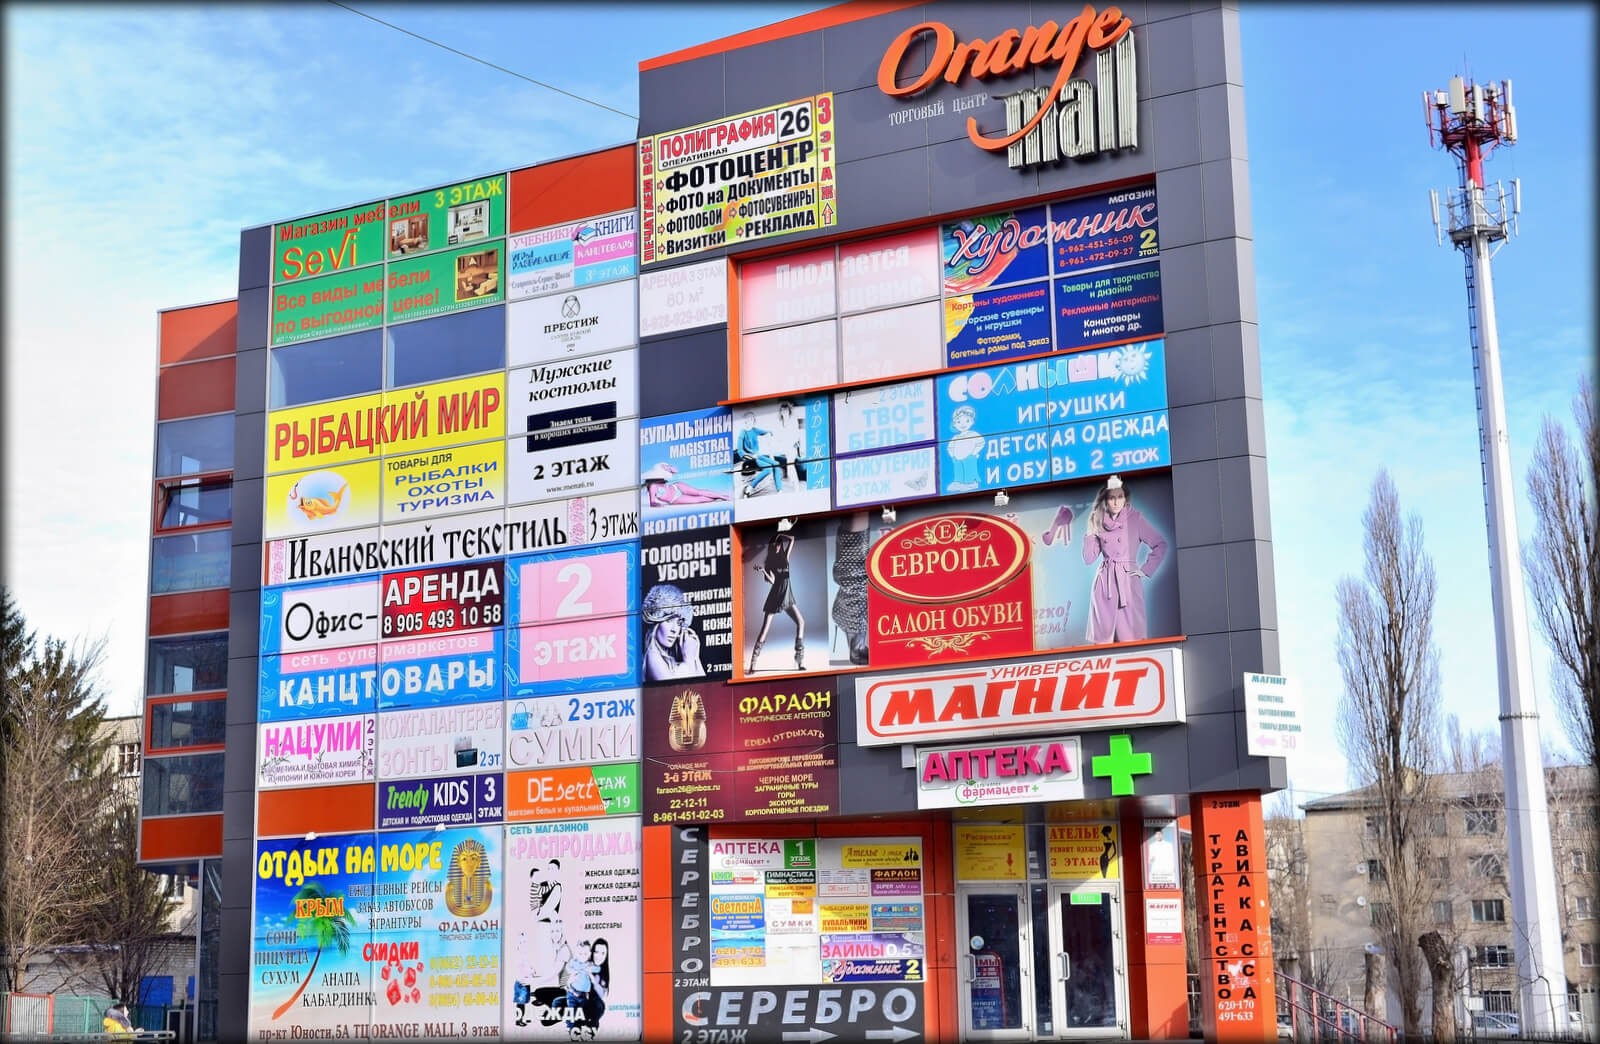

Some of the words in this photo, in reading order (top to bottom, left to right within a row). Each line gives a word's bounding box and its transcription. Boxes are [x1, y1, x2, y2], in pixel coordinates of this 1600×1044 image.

[877, 4, 1132, 150] Orange
[818, 97, 831, 124] 3
[888, 101, 944, 126] ТОРГОВЫЙ
[951, 92, 988, 112] ЦЕНТР
[991, 30, 1138, 168] mall
[660, 112, 776, 161] ПОЛИГРАФИЯ
[779, 107, 810, 137] 26
[662, 147, 728, 168] ОПЕРАТИВНАЯ
[665, 140, 814, 192] ФОТОЦЕНТР
[434, 191, 445, 209] 3
[450, 178, 503, 205] ЭТАЖ
[666, 192, 704, 213] ФОТО
[707, 190, 724, 205] на
[727, 167, 815, 203] ДОКУМЕНТЫ
[1108, 188, 1155, 205] магазин
[738, 188, 815, 219] ФОТОСУВЕНИРЫ
[280, 213, 348, 241] Магазин
[353, 200, 420, 227] мебели
[595, 215, 635, 237] КНИГИ
[667, 208, 722, 235] ФОТООБОИ
[744, 210, 816, 238] РЕКЛАМА
[666, 231, 726, 255] ВИЗИТКИ
[951, 203, 1159, 275] Художник
[1059, 235, 1134, 255] 8-962-451-56-09
[1140, 229, 1157, 249] 2
[1059, 247, 1134, 267] 8-961-472-09-27
[1138, 248, 1159, 256] этаж
[276, 291, 306, 312] Все
[312, 281, 358, 305] виды
[363, 269, 430, 293] мебели
[1062, 281, 1093, 294] Товары
[1095, 279, 1110, 290] для
[1113, 270, 1160, 285] творчества
[275, 319, 296, 335] по
[301, 300, 384, 332] выгодной
[392, 288, 440, 314] цене!
[1061, 302, 1109, 317] Рекламные
[1110, 293, 1160, 309] материалы
[544, 316, 599, 334] ПРЕСТИЖ
[1083, 312, 1141, 329] Канцтовары
[529, 359, 612, 384] Мужские
[528, 377, 617, 402] костюмы
[1018, 391, 1125, 424] ИГРУШКИ
[275, 391, 428, 461] РЫБАЦКИЙ
[438, 387, 500, 435] МИР
[640, 413, 732, 446] КУПАЛЬНИКИ
[669, 438, 730, 459] MAGISTRAL
[985, 426, 1076, 460] ДЕТСКАЯ
[1081, 414, 1169, 443] ОДЕЖДА
[387, 455, 429, 472] ТОВАРЫ
[431, 453, 452, 466] ДЛЯ
[533, 464, 544, 480] 2
[690, 451, 730, 470] REBECA
[986, 467, 1000, 485] И
[1006, 456, 1076, 482] ОБУВЬ
[1091, 449, 1104, 470] 2
[1111, 447, 1159, 468] этаж
[395, 461, 498, 486] РЫБАЛКИ
[407, 478, 483, 497] ОХОТЫ
[397, 490, 495, 513] ТУРИЗМА
[643, 510, 731, 536] КОЛГОТКИ
[641, 538, 731, 566] ГОЛОВНЫЕ
[890, 541, 1001, 578] ЕВРОПА
[657, 558, 717, 582] УБОРЫ
[384, 567, 500, 607] АРЕНДА
[555, 563, 593, 615] 2
[383, 618, 392, 635] 8
[397, 612, 423, 632] 905
[427, 608, 455, 629] 493
[461, 607, 478, 626] 10
[483, 604, 502, 623] 58
[693, 601, 732, 617] ЗАМША
[877, 609, 946, 636] САЛОН
[952, 601, 1023, 629] ОБУВИ
[291, 653, 330, 669] сеть
[337, 636, 479, 665] супермаркетов
[533, 633, 617, 668] этаж
[990, 658, 1112, 679] УНИВЕРСАМ
[278, 659, 495, 708] КАНЦТОВАРЫ
[738, 690, 831, 714] ФАРАОН
[878, 667, 1150, 726] МАГНИТ
[568, 698, 580, 721] 2
[583, 699, 635, 720] этаж
[739, 714, 793, 724] ТУРИСТИЧЕСКОЕ
[793, 711, 831, 720] АГЕНТСТВО
[367, 719, 374, 733] 2
[265, 721, 361, 760] НАЦУМИ
[510, 724, 637, 766] СУМКИ
[382, 744, 449, 776] ЗОНТЫ
[480, 752, 486, 767] 2
[922, 743, 1073, 783] АПТЕКА
[484, 777, 495, 802] 3
[527, 776, 596, 803] DEsert
[754, 783, 799, 792] ЗАГРАНИЧНЫЕ
[800, 782, 818, 790] ТУРЫ
[759, 775, 790, 784] ЧЕРНОЕ
[791, 773, 813, 783] МОРЕ
[387, 784, 429, 815] Trendy
[433, 780, 469, 807] KIDS
[769, 799, 804, 807] ЭКСКУРСИИ
[777, 791, 795, 799] ГОРЫ
[962, 783, 1030, 799] фармацевт
[478, 807, 502, 818] ЭТАЖ
[670, 798, 707, 809] 22-12-11
[653, 810, 724, 823] 8-961-451-02-03
[510, 827, 532, 835] СЕТЬ
[536, 823, 589, 833] МАГАЗИНОВ
[1049, 827, 1099, 840] АТЕЛЬЕ
[713, 842, 781, 855] АПТЕКА
[796, 841, 803, 856] 1
[258, 848, 339, 887] ОТДЫХ
[345, 845, 375, 874] НА
[381, 841, 443, 873] МОРЕ
[585, 869, 613, 877] ЖЕНСКАЯ
[1064, 856, 1099, 867] ЭТАЖ
[584, 882, 614, 890] МУЖСКАЯ
[615, 881, 641, 889] ОДЕЖДА
[295, 897, 344, 919] КРЫМ
[680, 827, 704, 974] СЕРЕБРО
[1209, 834, 1231, 999] ТУРАГЕНТСТВО
[1235, 829, 1256, 999] АВИАКАССА
[266, 931, 297, 945] СОЧИ
[438, 920, 499, 933] ФАРАОН
[254, 950, 309, 967] ПИЦУНДА
[362, 941, 419, 968] СКИДКИ
[822, 942, 884, 958] ЗАЙМЫ
[261, 970, 300, 985] СУХУМ
[906, 960, 919, 974] 2
[322, 972, 360, 987] АНАПА
[303, 991, 377, 1008] КАБАРДИНКА
[681, 987, 917, 1026] СЕРЕБРО
[1218, 1000, 1254, 1010] 620-170
[1218, 1011, 1254, 1021] 491-633
[259, 1026, 287, 1040] пр-кт
[353, 1025, 370, 1040] ТЦ
[372, 1022, 420, 1039] ORANGE
[471, 1026, 499, 1039] этаж
